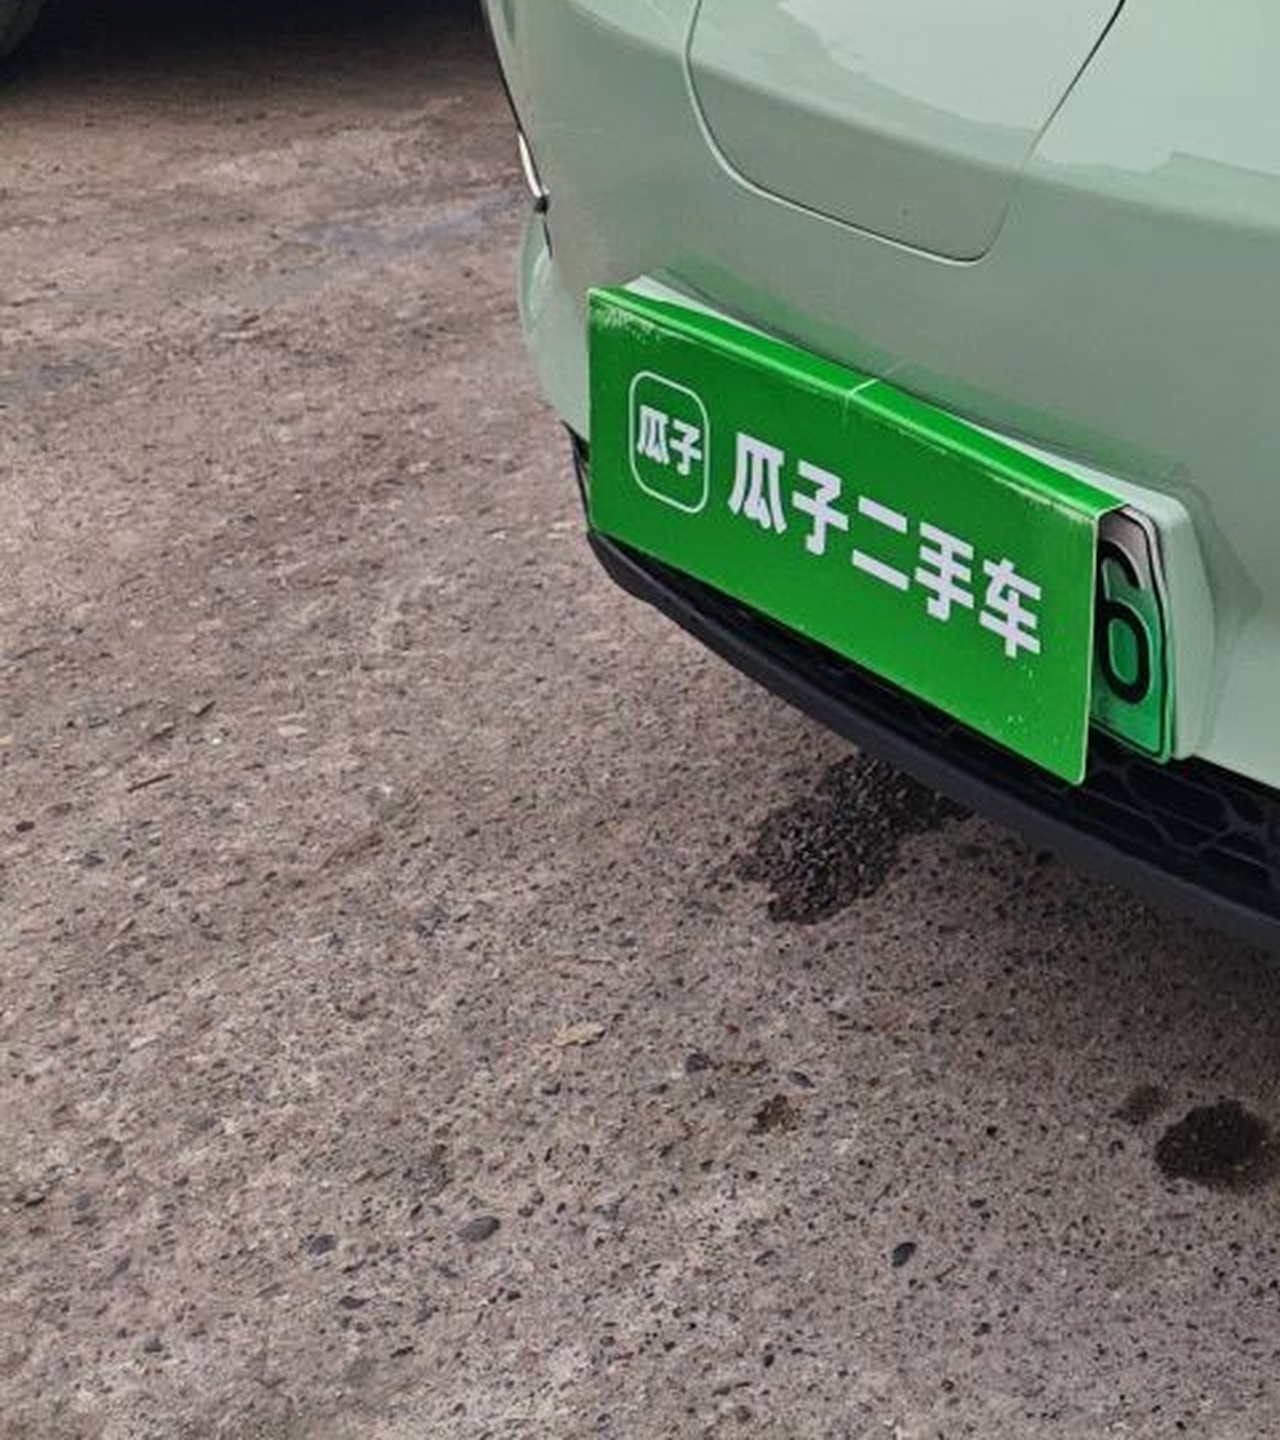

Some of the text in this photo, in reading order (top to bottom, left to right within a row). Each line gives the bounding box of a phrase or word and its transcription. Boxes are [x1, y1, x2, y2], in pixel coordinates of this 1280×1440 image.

[636, 404, 703, 476] 瓜子
[727, 431, 1042, 659] 瓜子二手车
